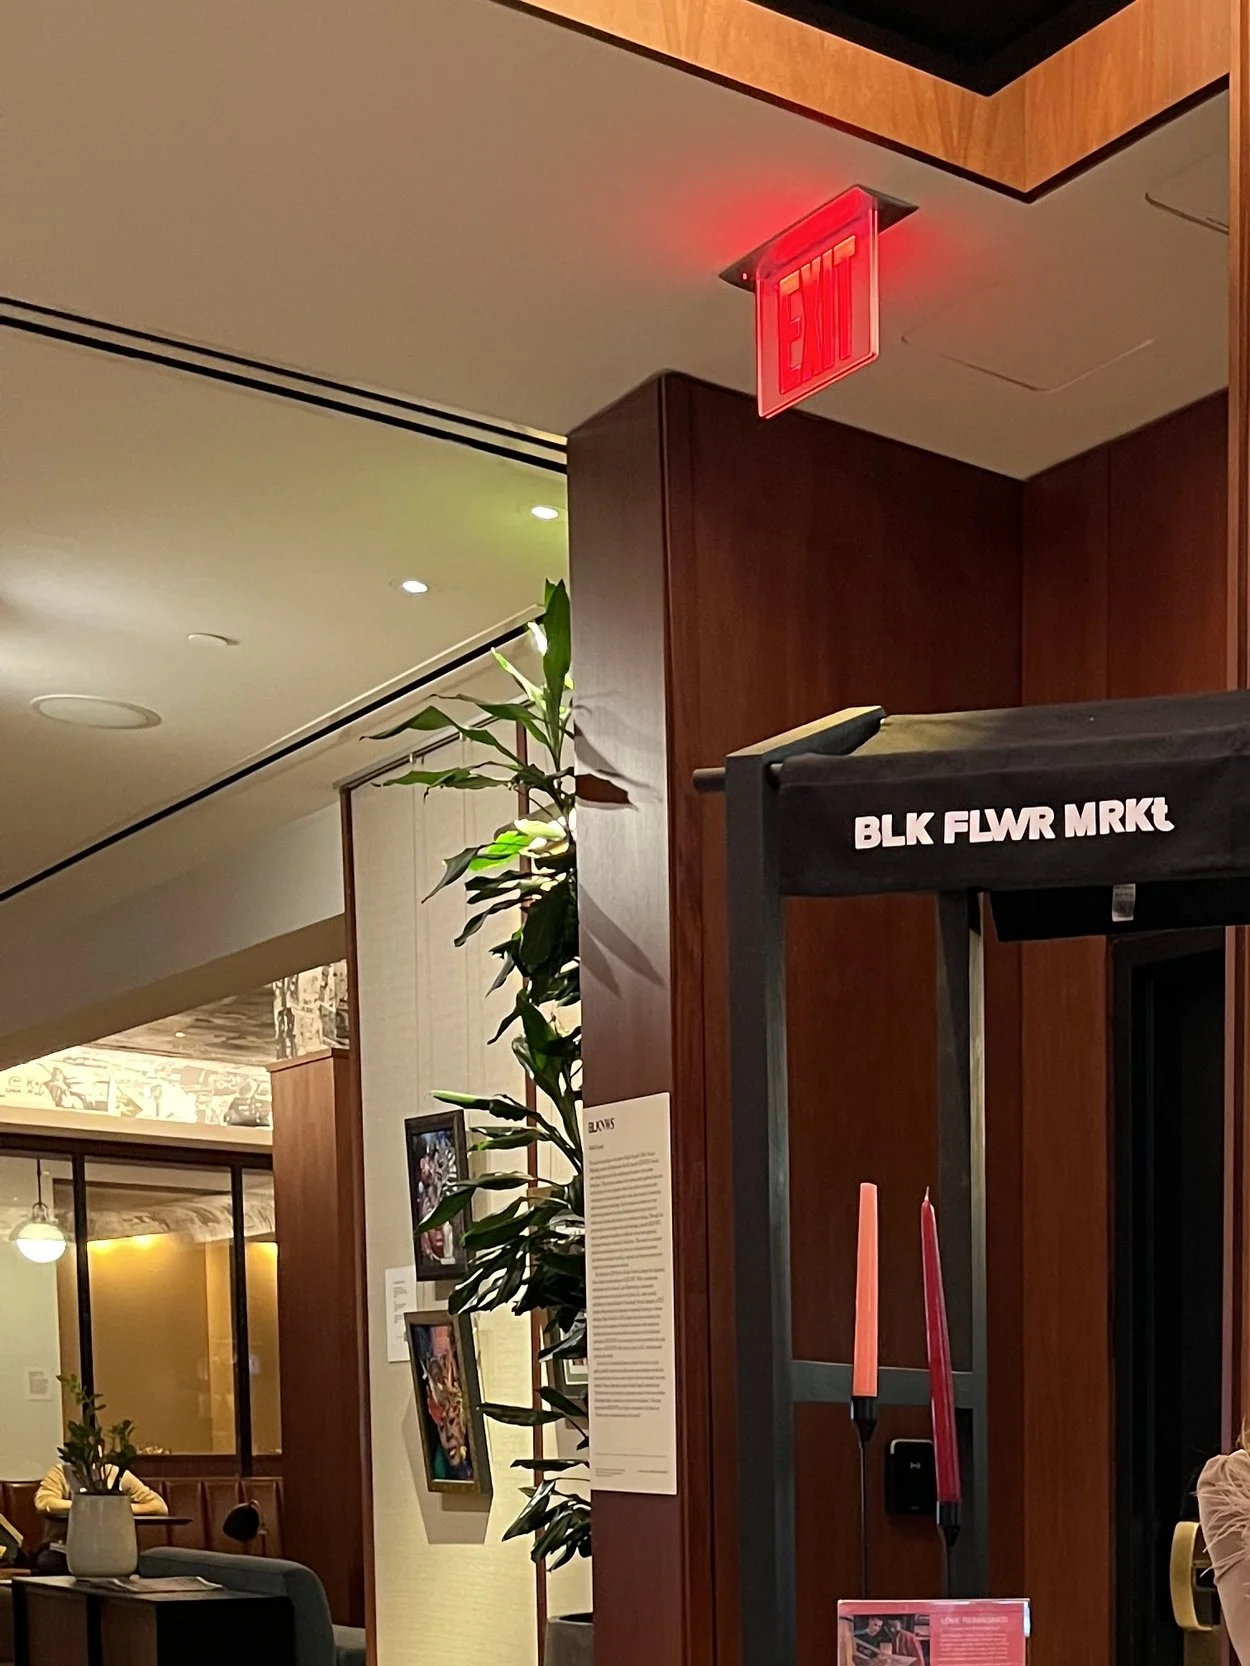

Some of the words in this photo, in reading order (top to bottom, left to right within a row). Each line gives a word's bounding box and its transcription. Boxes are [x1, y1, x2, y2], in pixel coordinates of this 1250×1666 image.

[777, 235, 856, 395] EXIT
[854, 812, 935, 849] BLK
[943, 806, 1056, 844] FLWR
